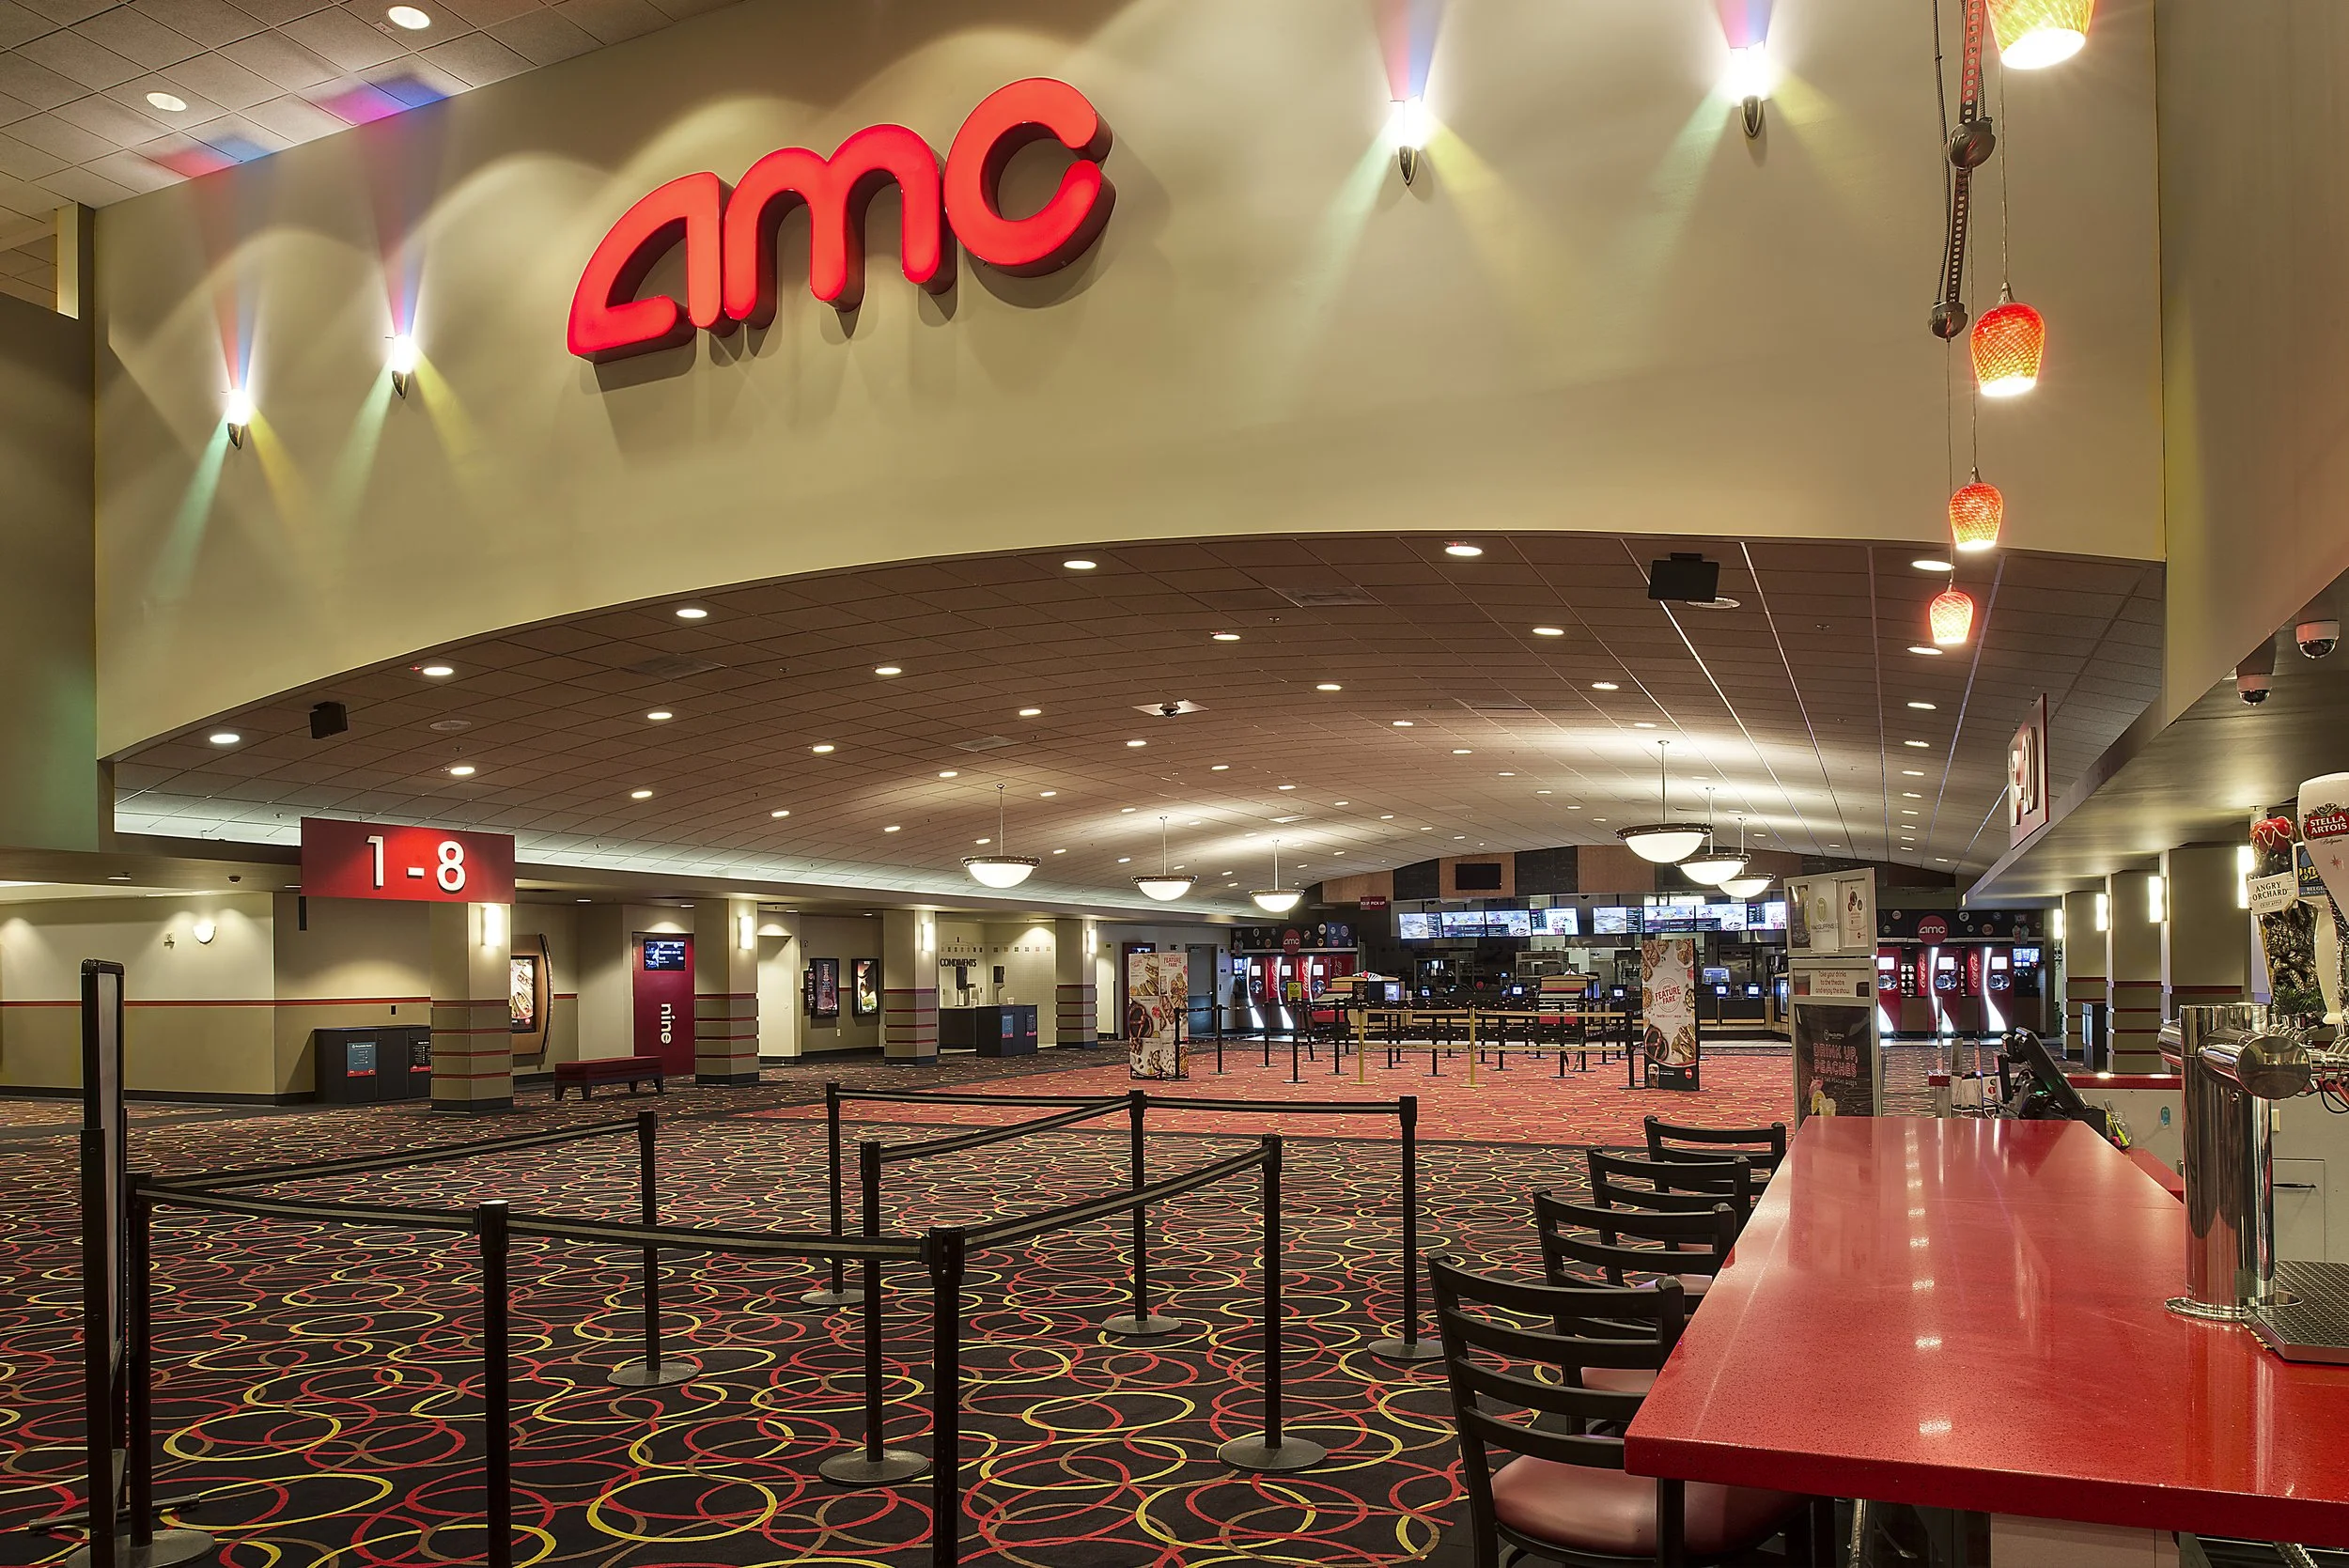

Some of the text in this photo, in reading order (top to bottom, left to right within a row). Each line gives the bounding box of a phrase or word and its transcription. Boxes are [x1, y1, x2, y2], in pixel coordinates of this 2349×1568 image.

[2310, 815, 2346, 827] STELLA
[2311, 822, 2348, 834] ARTOIS
[2256, 881, 2281, 893] ANGRY
[2252, 889, 2288, 902] ORCHARD
[940, 958, 977, 967] CONDIMENTS
[1655, 986, 1681, 1001] FEATURE
[1663, 995, 1676, 1004] FARE
[661, 1003, 676, 1044] nine
[1813, 1043, 1859, 1063] DRINK UP,
[1813, 1059, 1857, 1078] PEACHES
